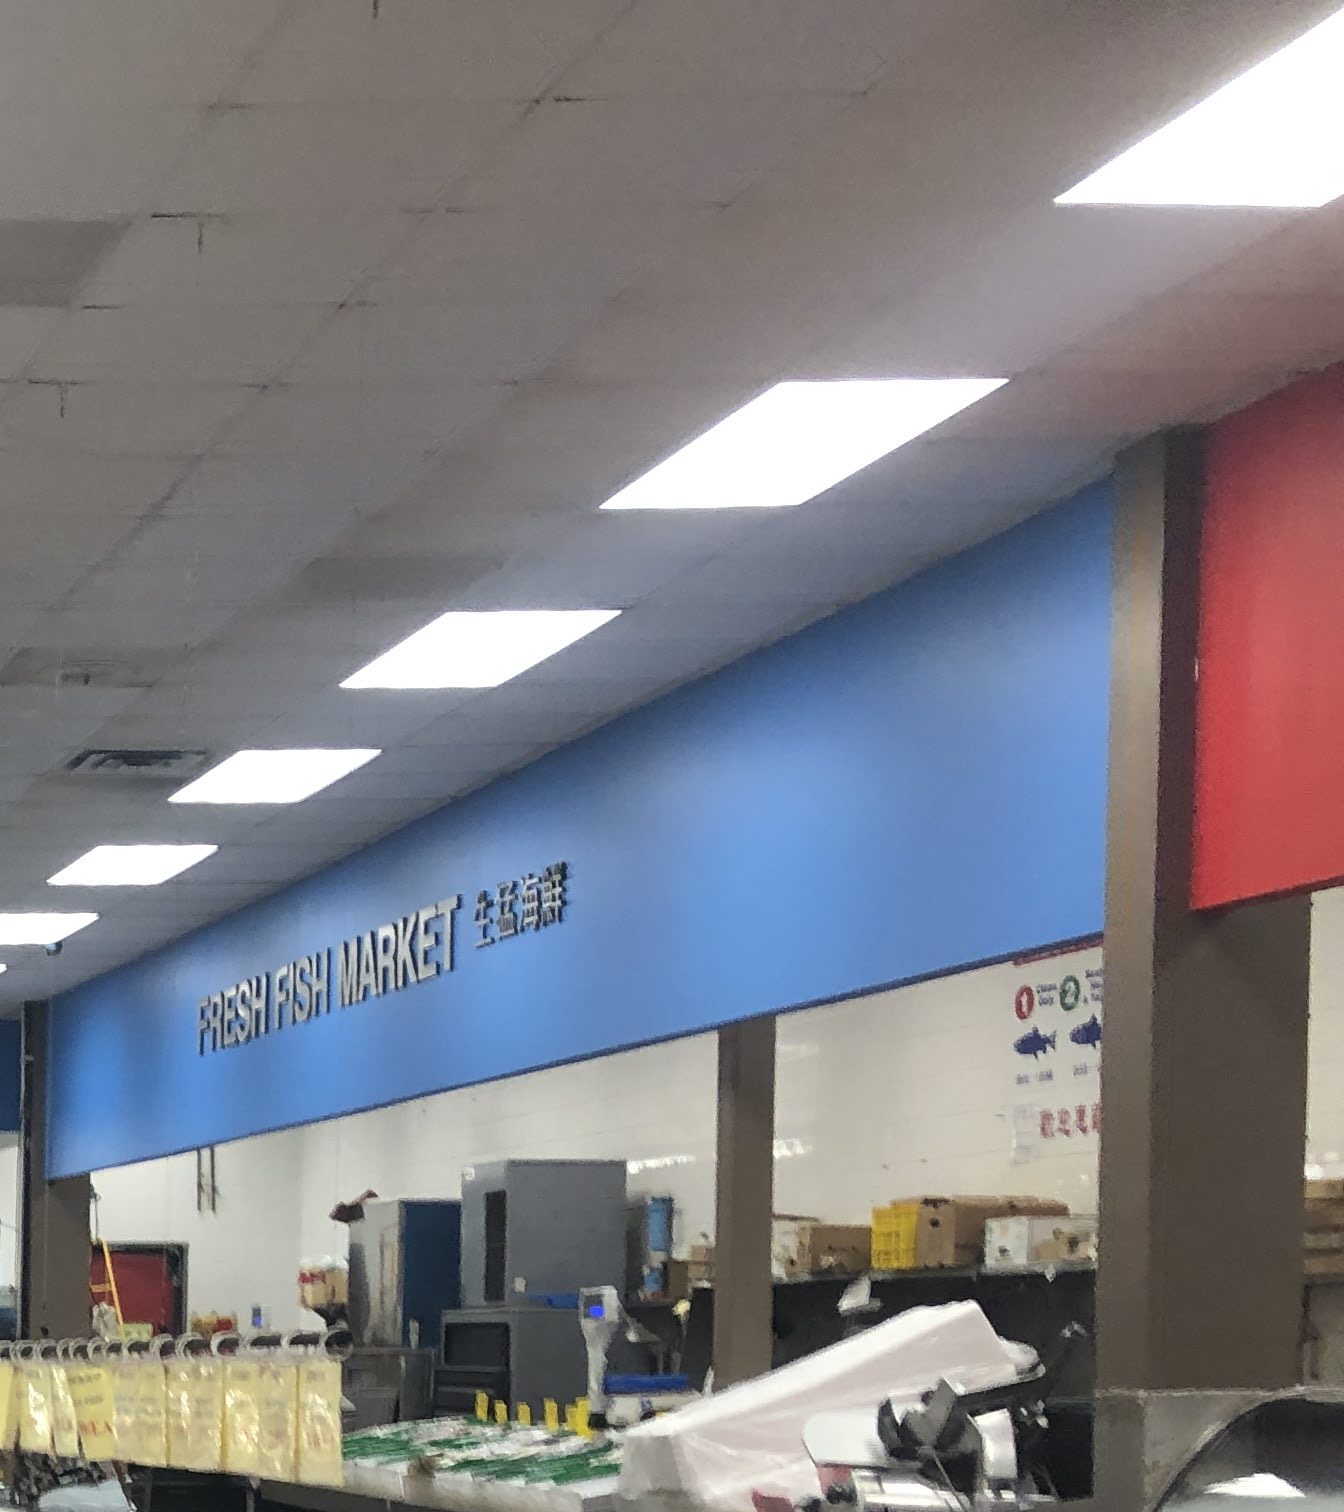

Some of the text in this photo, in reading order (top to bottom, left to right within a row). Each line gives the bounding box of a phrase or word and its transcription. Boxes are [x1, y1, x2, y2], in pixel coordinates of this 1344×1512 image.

[197, 893, 462, 1056] FRESH FISH MARKET
